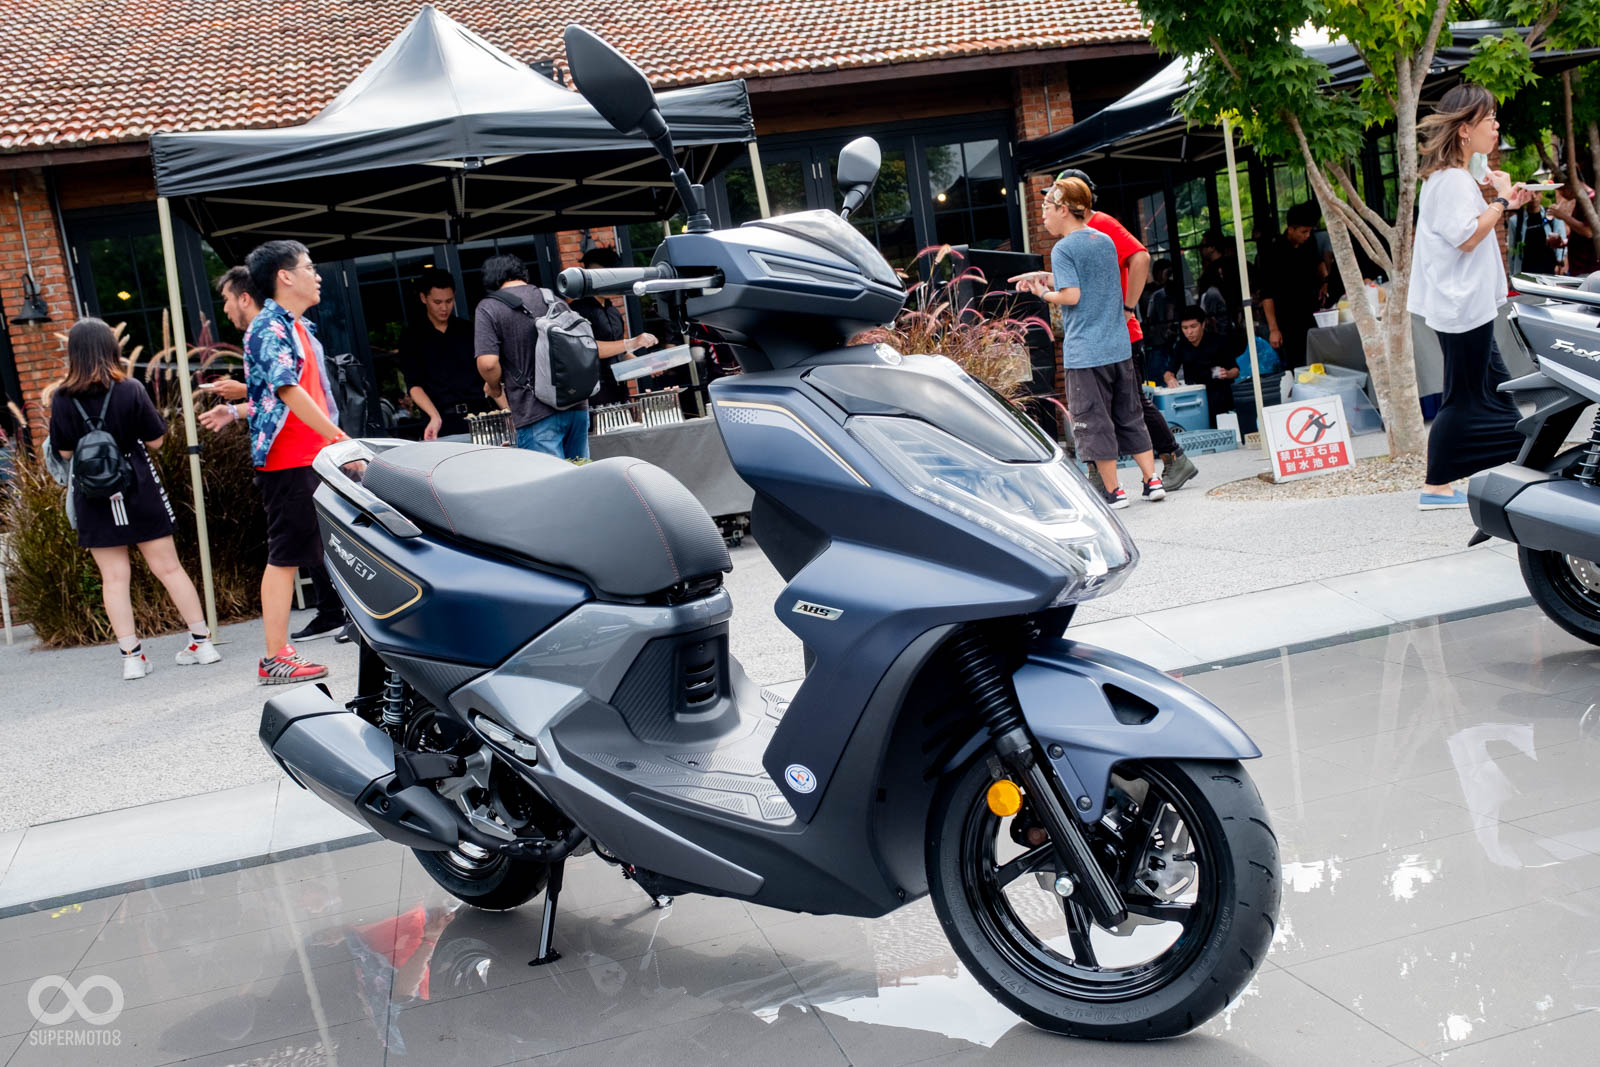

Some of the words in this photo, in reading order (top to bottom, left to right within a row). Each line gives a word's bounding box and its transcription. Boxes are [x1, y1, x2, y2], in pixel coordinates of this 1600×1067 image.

[1285, 455, 1339, 473] 到水池中
[797, 604, 830, 616] ABS
